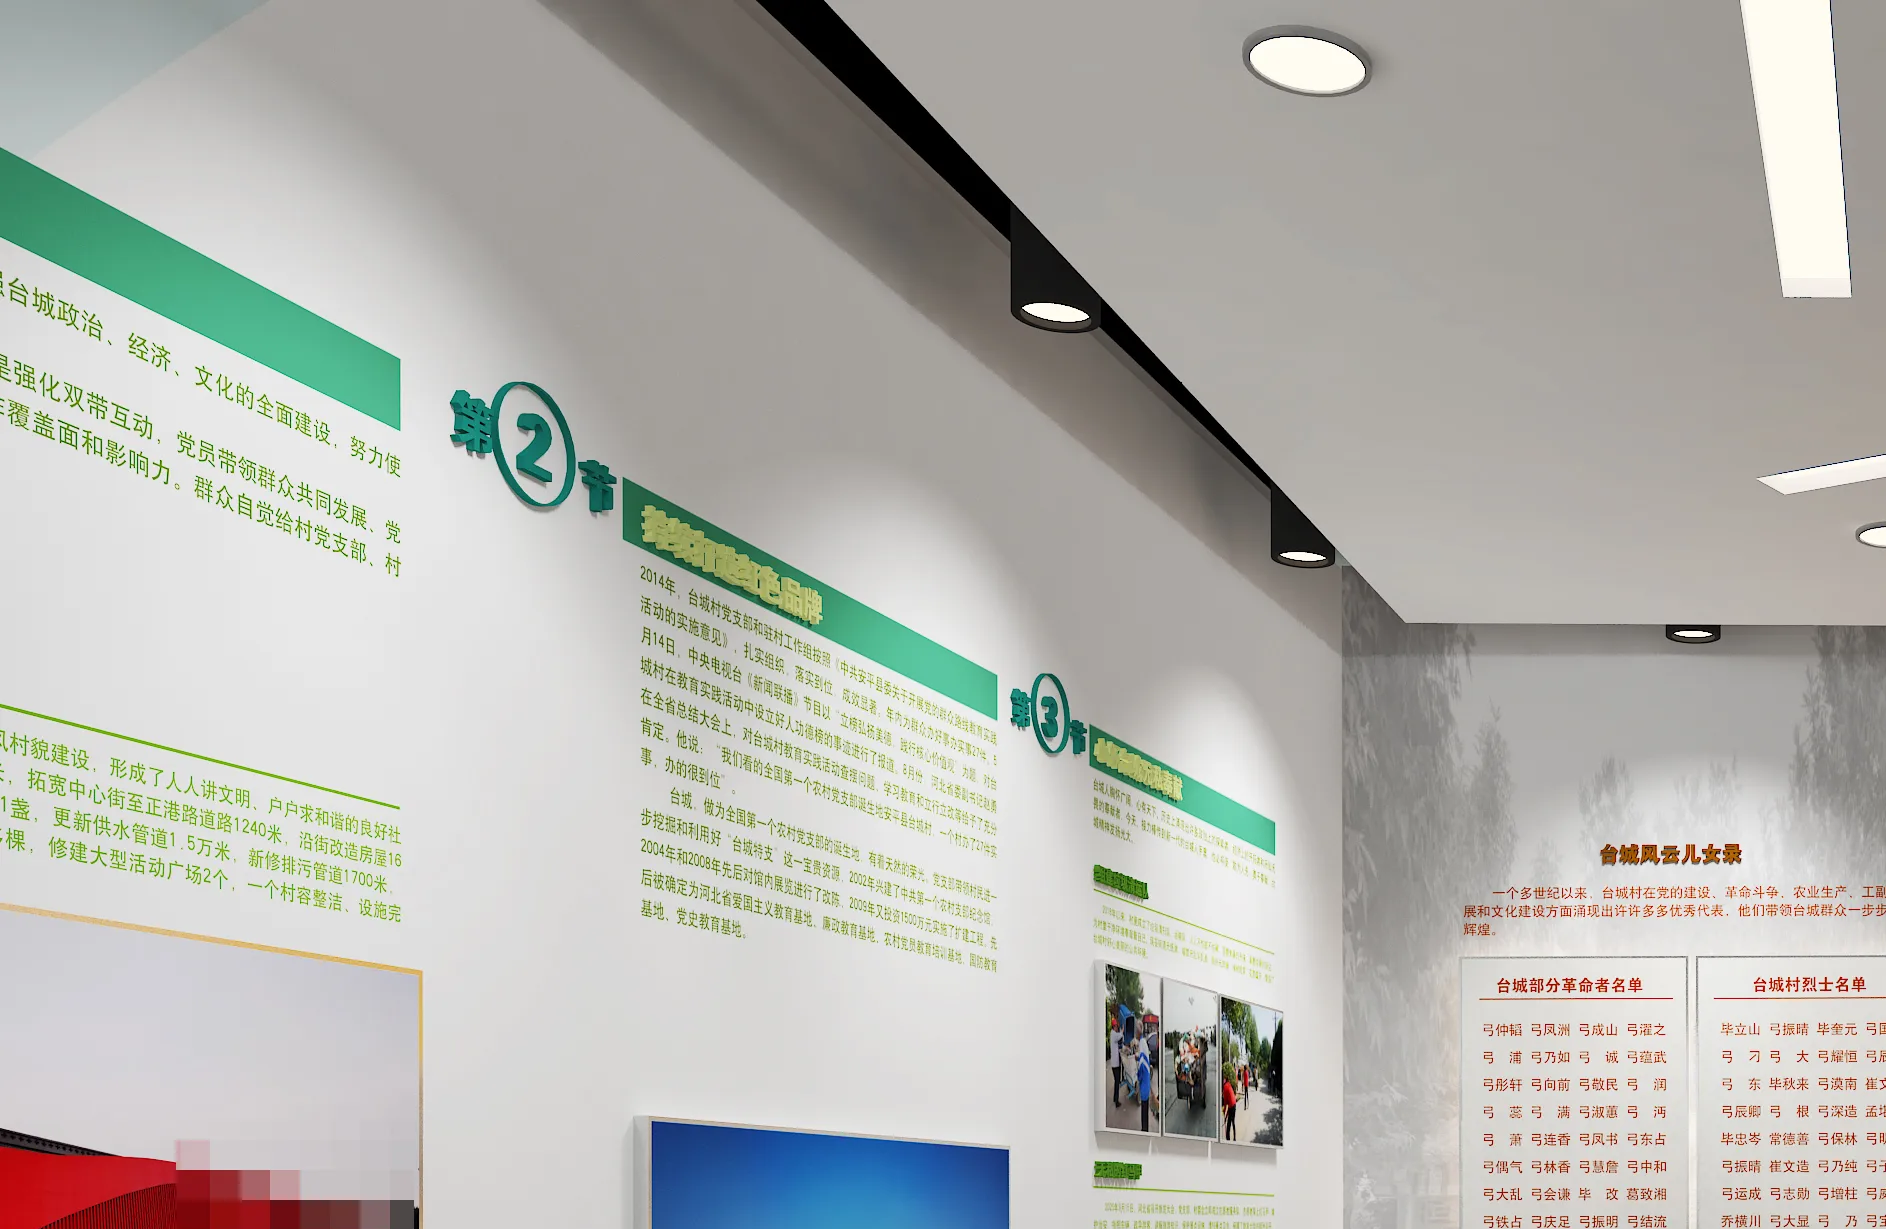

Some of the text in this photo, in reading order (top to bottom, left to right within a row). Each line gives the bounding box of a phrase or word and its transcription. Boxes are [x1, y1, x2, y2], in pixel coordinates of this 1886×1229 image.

[0, 270, 402, 478] 台城政治、经济、文化的全面建设，努力使
[0, 397, 402, 578] 覆盖面和影响力。群众自觉给村党支部、村
[0, 763, 402, 867] ，拓宽中心街至正港路道路1240米，沿街改造房屋16
[1600, 843, 1743, 865] 台城风云儿女录
[0, 828, 402, 923] 棵，修建大型活动广场2个，一个村容整洁、设施完
[1463, 922, 1499, 937] 辉煌。
[1497, 977, 1642, 994] 台城部分革命者名单
[1753, 976, 1867, 993] 台城村烈士名单
[1531, 1023, 1571, 1037] 弓凤洲
[1579, 1023, 1619, 1037] 弓成山
[1721, 1021, 1762, 1037] 毕立山
[1769, 1021, 1810, 1037] 弓振晴
[1531, 1050, 1571, 1065] 弓乃如
[1817, 1049, 1858, 1065] 弓耀恒
[1483, 1077, 1523, 1093] 弓彤轩
[1531, 1077, 1571, 1093] 弓向前
[1579, 1077, 1619, 1093] 弓敬民
[1769, 1076, 1810, 1092] 毕秋来
[1721, 1103, 1762, 1119] 弓辰卿
[1817, 1103, 1858, 1119] 弓深造
[1531, 1132, 1571, 1147] 弓连香
[1579, 1132, 1619, 1147] 弓凤书
[1627, 1132, 1667, 1147] 弓东占
[1721, 1131, 1762, 1147] 毕忠岑
[1769, 1131, 1810, 1147] 常德善
[1817, 1131, 1858, 1147] 弓保林
[1531, 1159, 1571, 1175] 弓林香
[1627, 1159, 1667, 1175] 弓中和
[1721, 1159, 1762, 1174] 弓振晴
[1769, 1159, 1810, 1174] 崔文造
[1817, 1159, 1858, 1174] 弓乃纯
[1483, 1187, 1523, 1202] 弓大乱
[1531, 1187, 1571, 1202] 弓会谦
[1721, 1186, 1762, 1202] 弓运成
[1769, 1186, 1810, 1202] 弓志勋
[1817, 1186, 1858, 1202] 弓增柱
[1483, 1215, 1667, 1229] 弓铁占 弓庆足 弓振明 弓结流
[1721, 1213, 1762, 1229] 乔横川
[1769, 1213, 1810, 1229] 弓大显
